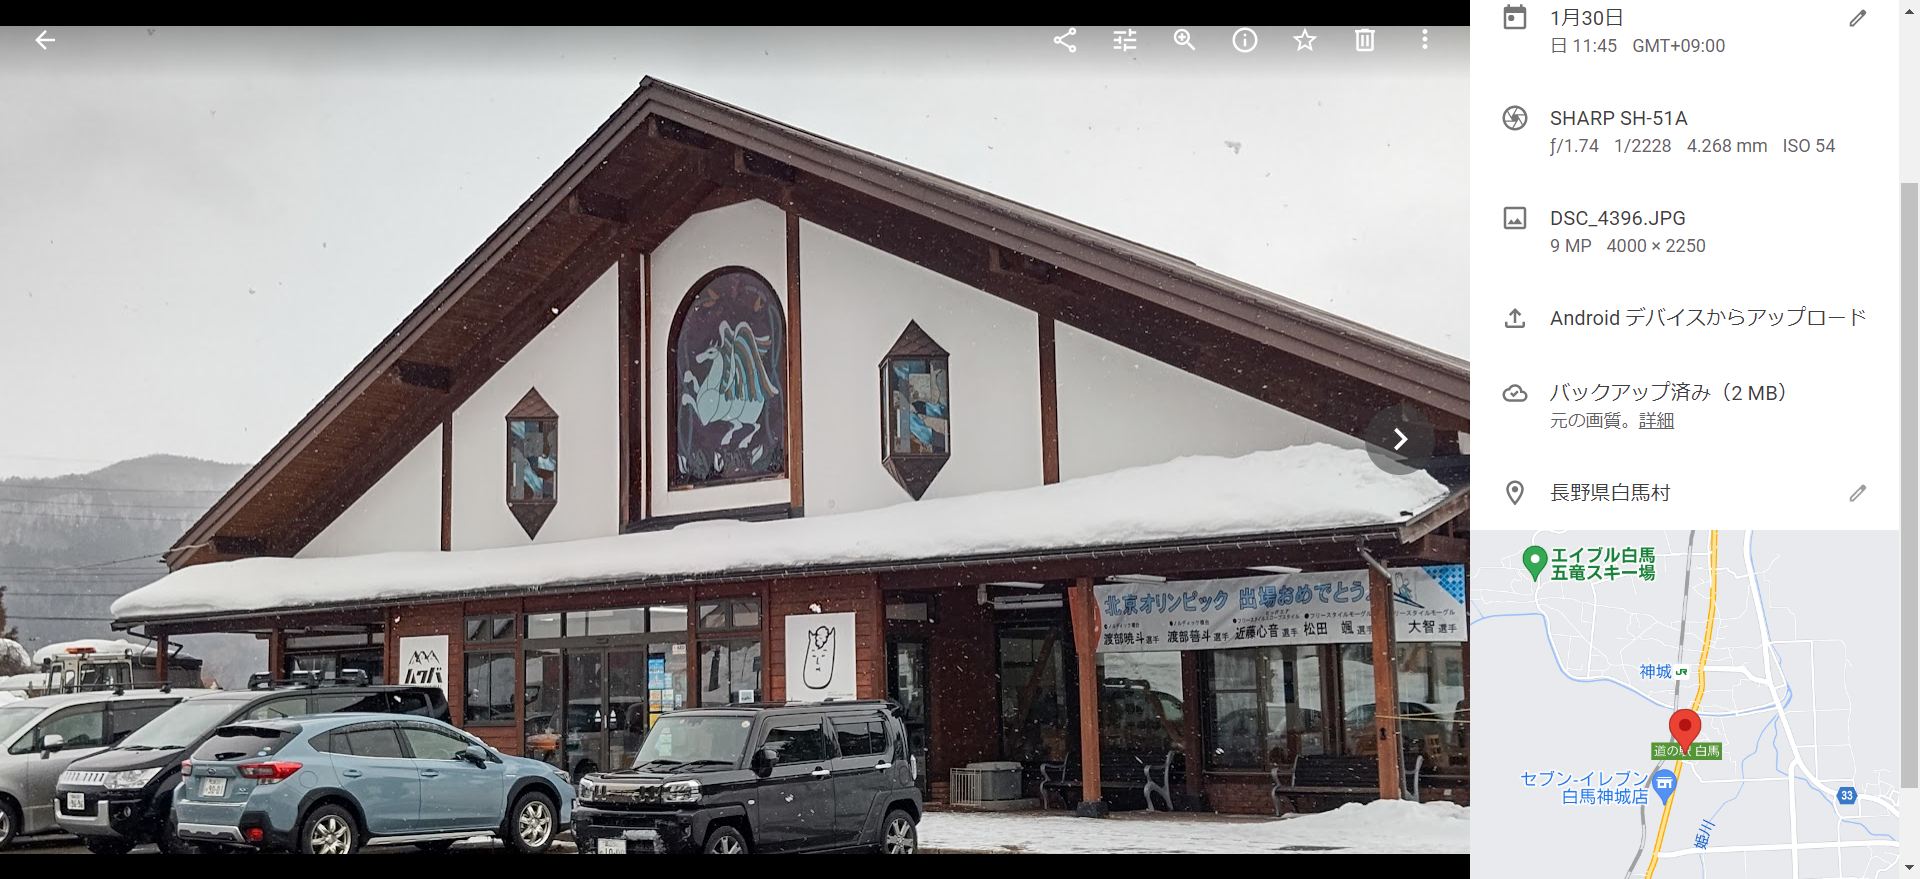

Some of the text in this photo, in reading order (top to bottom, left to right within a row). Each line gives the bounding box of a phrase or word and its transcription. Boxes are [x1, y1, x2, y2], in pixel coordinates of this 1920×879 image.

[1551, 8, 1623, 27] 1月30日
[1551, 37, 1726, 54] 日 11:45 GMT+09:00
[1550, 110, 1689, 126] SHARP SH-51A
[1614, 138, 1672, 154] 1/2228
[1686, 138, 1732, 153] 4.268
[1736, 141, 1768, 153] mm
[1783, 138, 1811, 153] ISO
[1816, 138, 1836, 153] 54
[1551, 210, 1686, 227] DSC_4396.JPG
[1550, 238, 1560, 253] 9
[1565, 238, 1592, 253] MP
[1606, 238, 1647, 253] 4000
[1665, 238, 1706, 253] 2250
[1549, 306, 1866, 327] Android デバイスからアップロード
[1550, 482, 1671, 502] 長野県白馬村
[1551, 547, 1655, 563] エイブル白馬
[1550, 564, 1655, 581] 五竜スキー場
[1104, 590, 1229, 616] 北京オリンピック
[1640, 663, 1672, 679] 神城
[1675, 668, 1688, 676] JR
[1695, 744, 1720, 758] 白馬
[1520, 770, 1648, 787] セブン-イレブン
[1562, 788, 1649, 805] 白馬神城店
[1841, 790, 1853, 800] 33
[1693, 819, 1716, 850] 姫川
